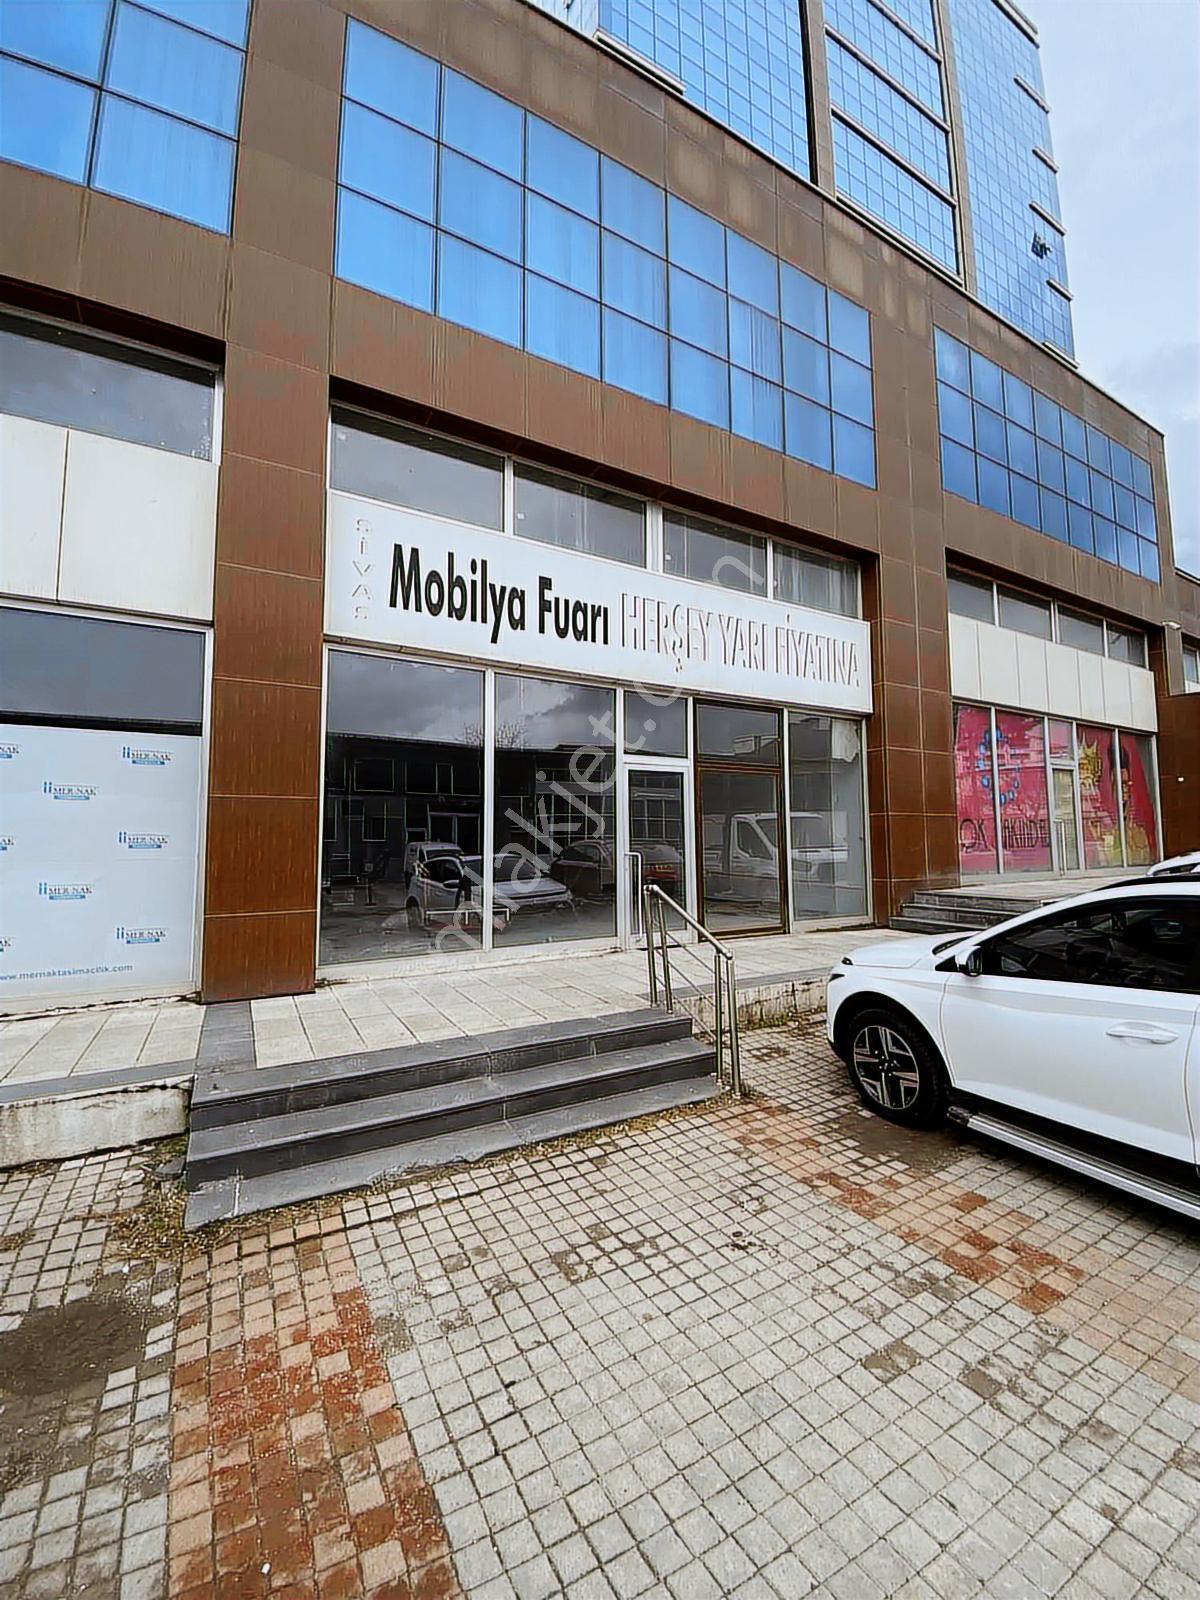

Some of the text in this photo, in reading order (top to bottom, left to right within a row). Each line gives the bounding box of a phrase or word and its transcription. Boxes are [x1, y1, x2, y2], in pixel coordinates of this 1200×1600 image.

[389, 542, 609, 645] Mobilya Fuarı
[621, 592, 861, 688] HERŞEY YARI FİYATINA
